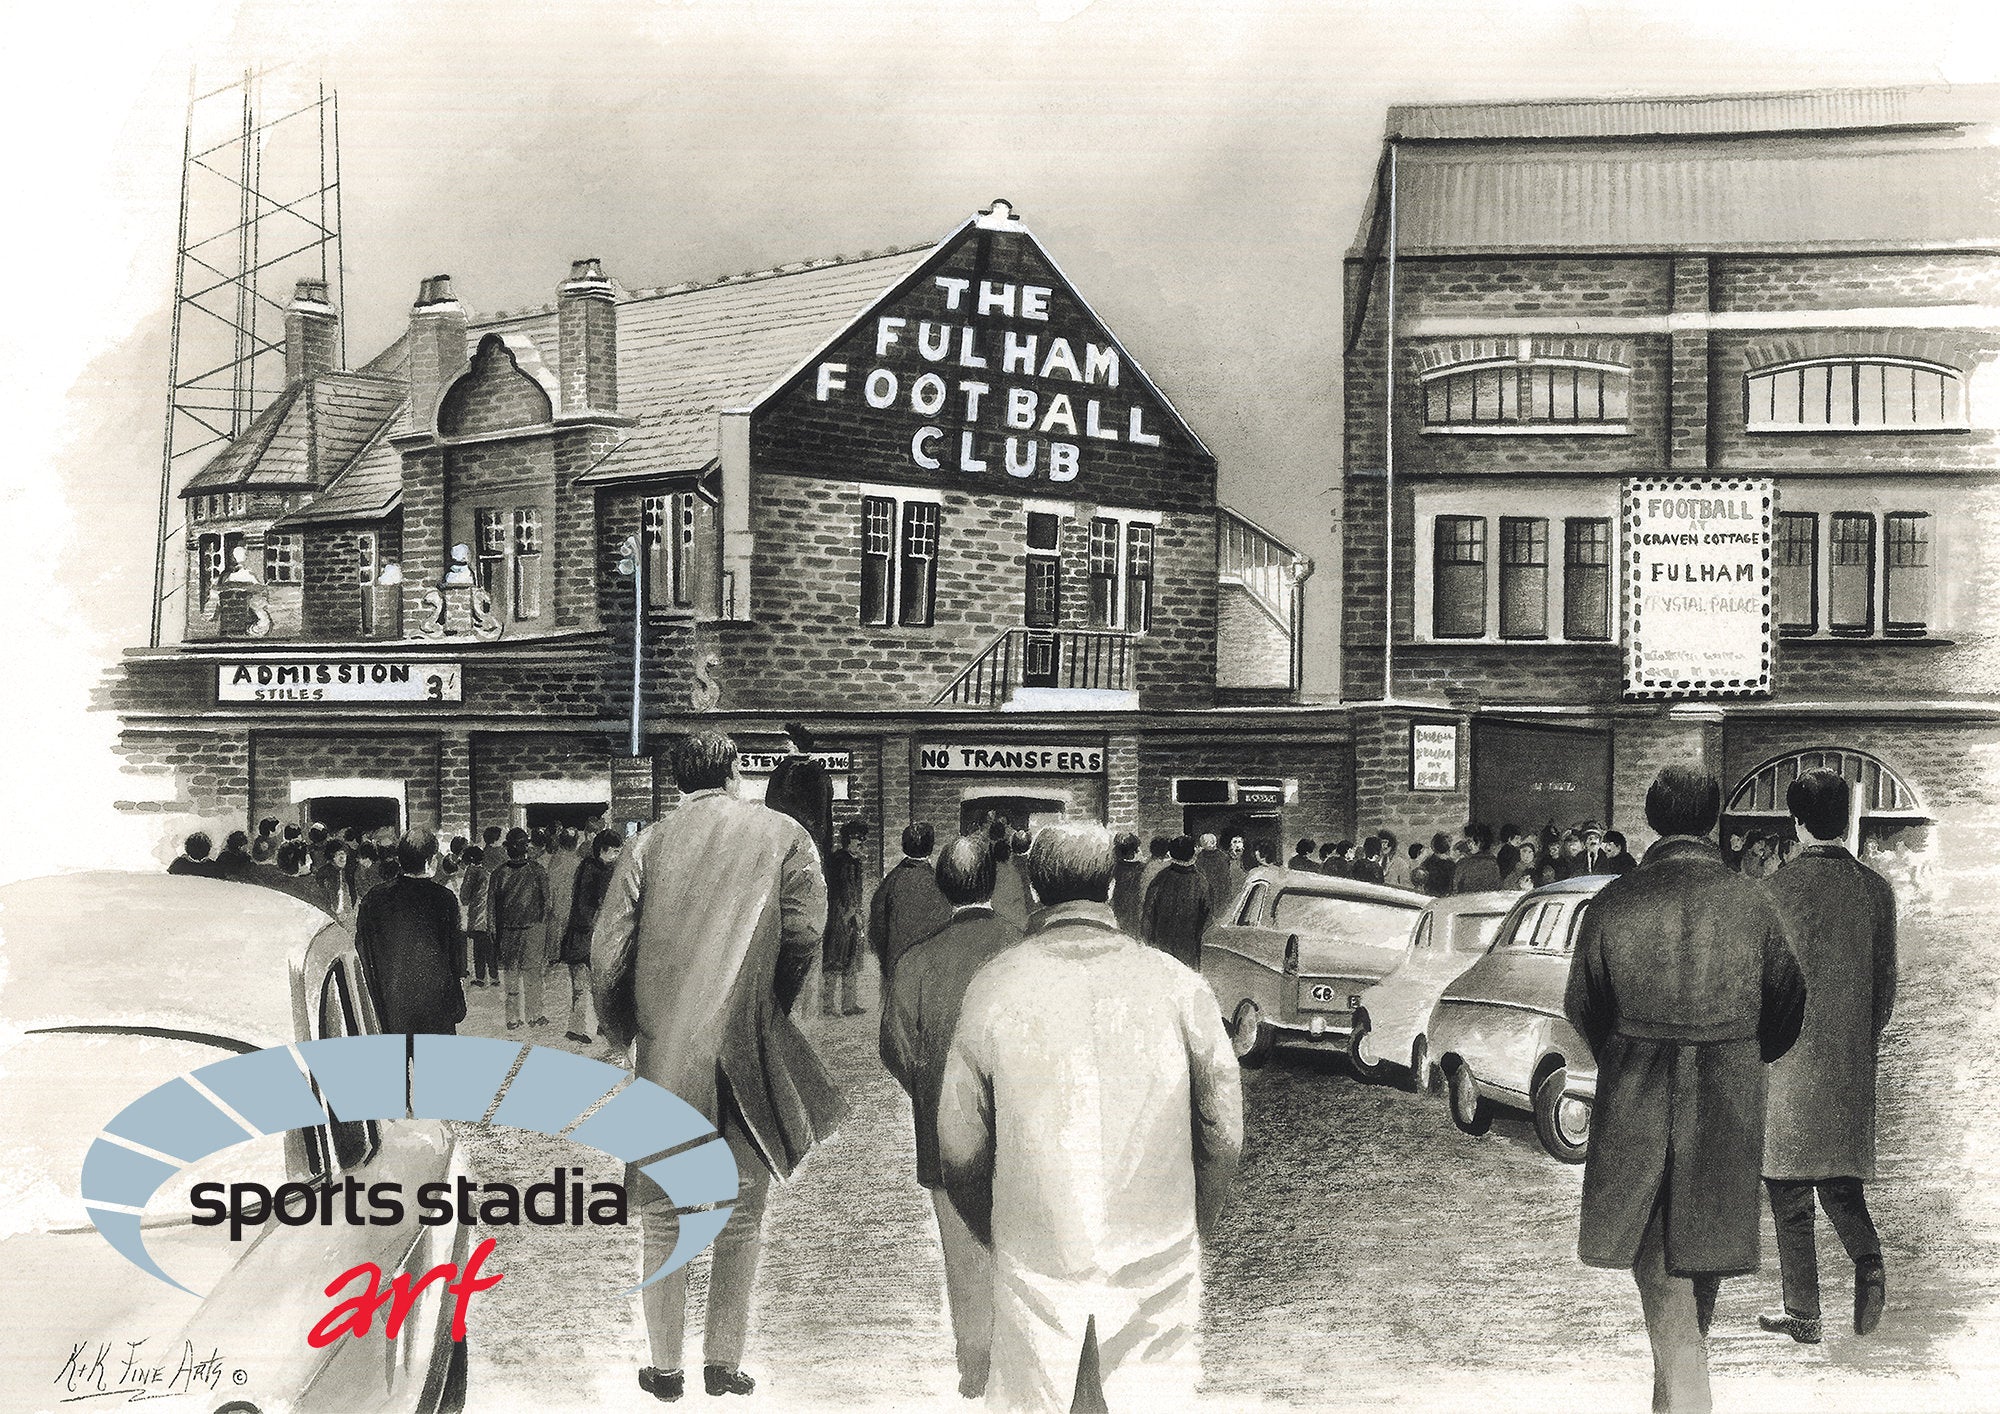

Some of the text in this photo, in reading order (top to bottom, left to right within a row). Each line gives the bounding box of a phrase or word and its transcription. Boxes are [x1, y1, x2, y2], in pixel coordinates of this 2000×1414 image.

[935, 276, 1053, 321] THE
[876, 316, 1120, 389] FULHAM
[816, 361, 1161, 447] FOOTBALL
[911, 426, 1080, 482] CLUB
[1648, 498, 1754, 520] FOOTBALL
[1703, 532, 1760, 545] COTTAGE
[1651, 562, 1755, 583] FULHAM
[1710, 596, 1761, 614] PALACE
[232, 664, 411, 684] ADMISSION
[254, 688, 324, 701] STILES
[960, 748, 1101, 771] TRANSFERS
